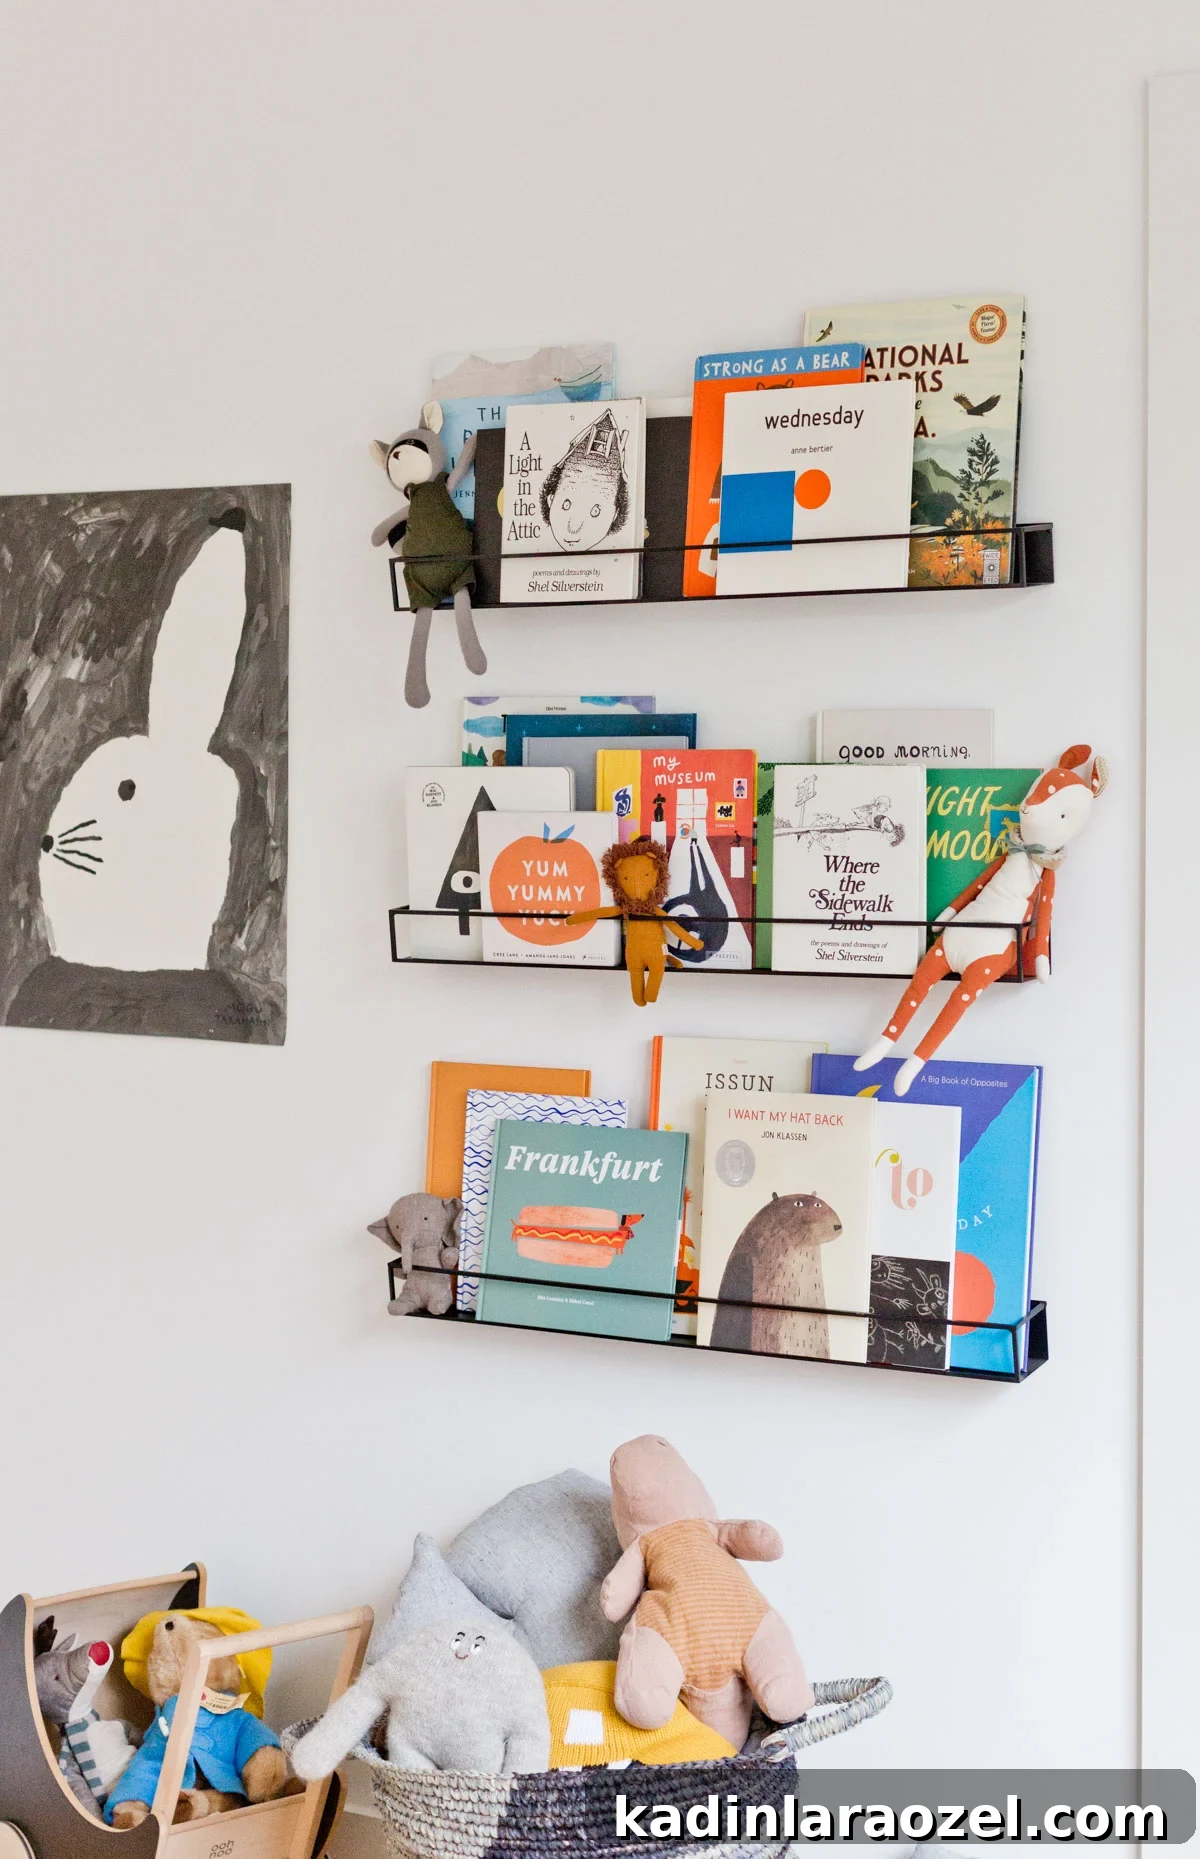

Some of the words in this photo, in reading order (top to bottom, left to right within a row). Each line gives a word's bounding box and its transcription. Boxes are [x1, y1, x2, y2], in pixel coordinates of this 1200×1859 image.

[703, 358, 764, 377] STRONG
[771, 357, 787, 372] AS
[796, 356, 805, 370] A
[813, 351, 850, 370] BEAR
[764, 405, 864, 429] wednesday
[520, 431, 531, 451] A
[790, 446, 807, 455] anne
[809, 445, 833, 454] bertier
[509, 453, 543, 478] Light
[517, 479, 531, 495] in
[513, 498, 536, 516] the
[507, 520, 541, 541] Attic
[532, 569, 553, 578] poems
[565, 568, 592, 578] drawings
[593, 568, 601, 577] by
[528, 580, 550, 592] Shel
[551, 580, 604, 592] Silverstein
[522, 860, 568, 877] YUM
[824, 854, 880, 874] Where
[507, 884, 586, 902] YUMMY
[839, 874, 866, 895] the
[809, 888, 894, 914] Sidewalk
[815, 948, 836, 961] Shel
[836, 949, 884, 963] Silverstein
[705, 1073, 774, 1092] ISSUN
[928, 1075, 940, 1084] Big
[942, 1076, 960, 1085] Book
[961, 1077, 970, 1085] of
[970, 1078, 1008, 1088] Opposites
[728, 1108, 732, 1119] I
[734, 1109, 766, 1121] WANT
[769, 1111, 787, 1123] MY
[790, 1112, 812, 1124] HAT
[814, 1114, 844, 1126] BACK
[762, 1130, 775, 1139] JON
[776, 1132, 808, 1141] KLASSEN
[504, 1145, 663, 1185] Frankfurt
[211, 1840, 235, 1852] ooh
